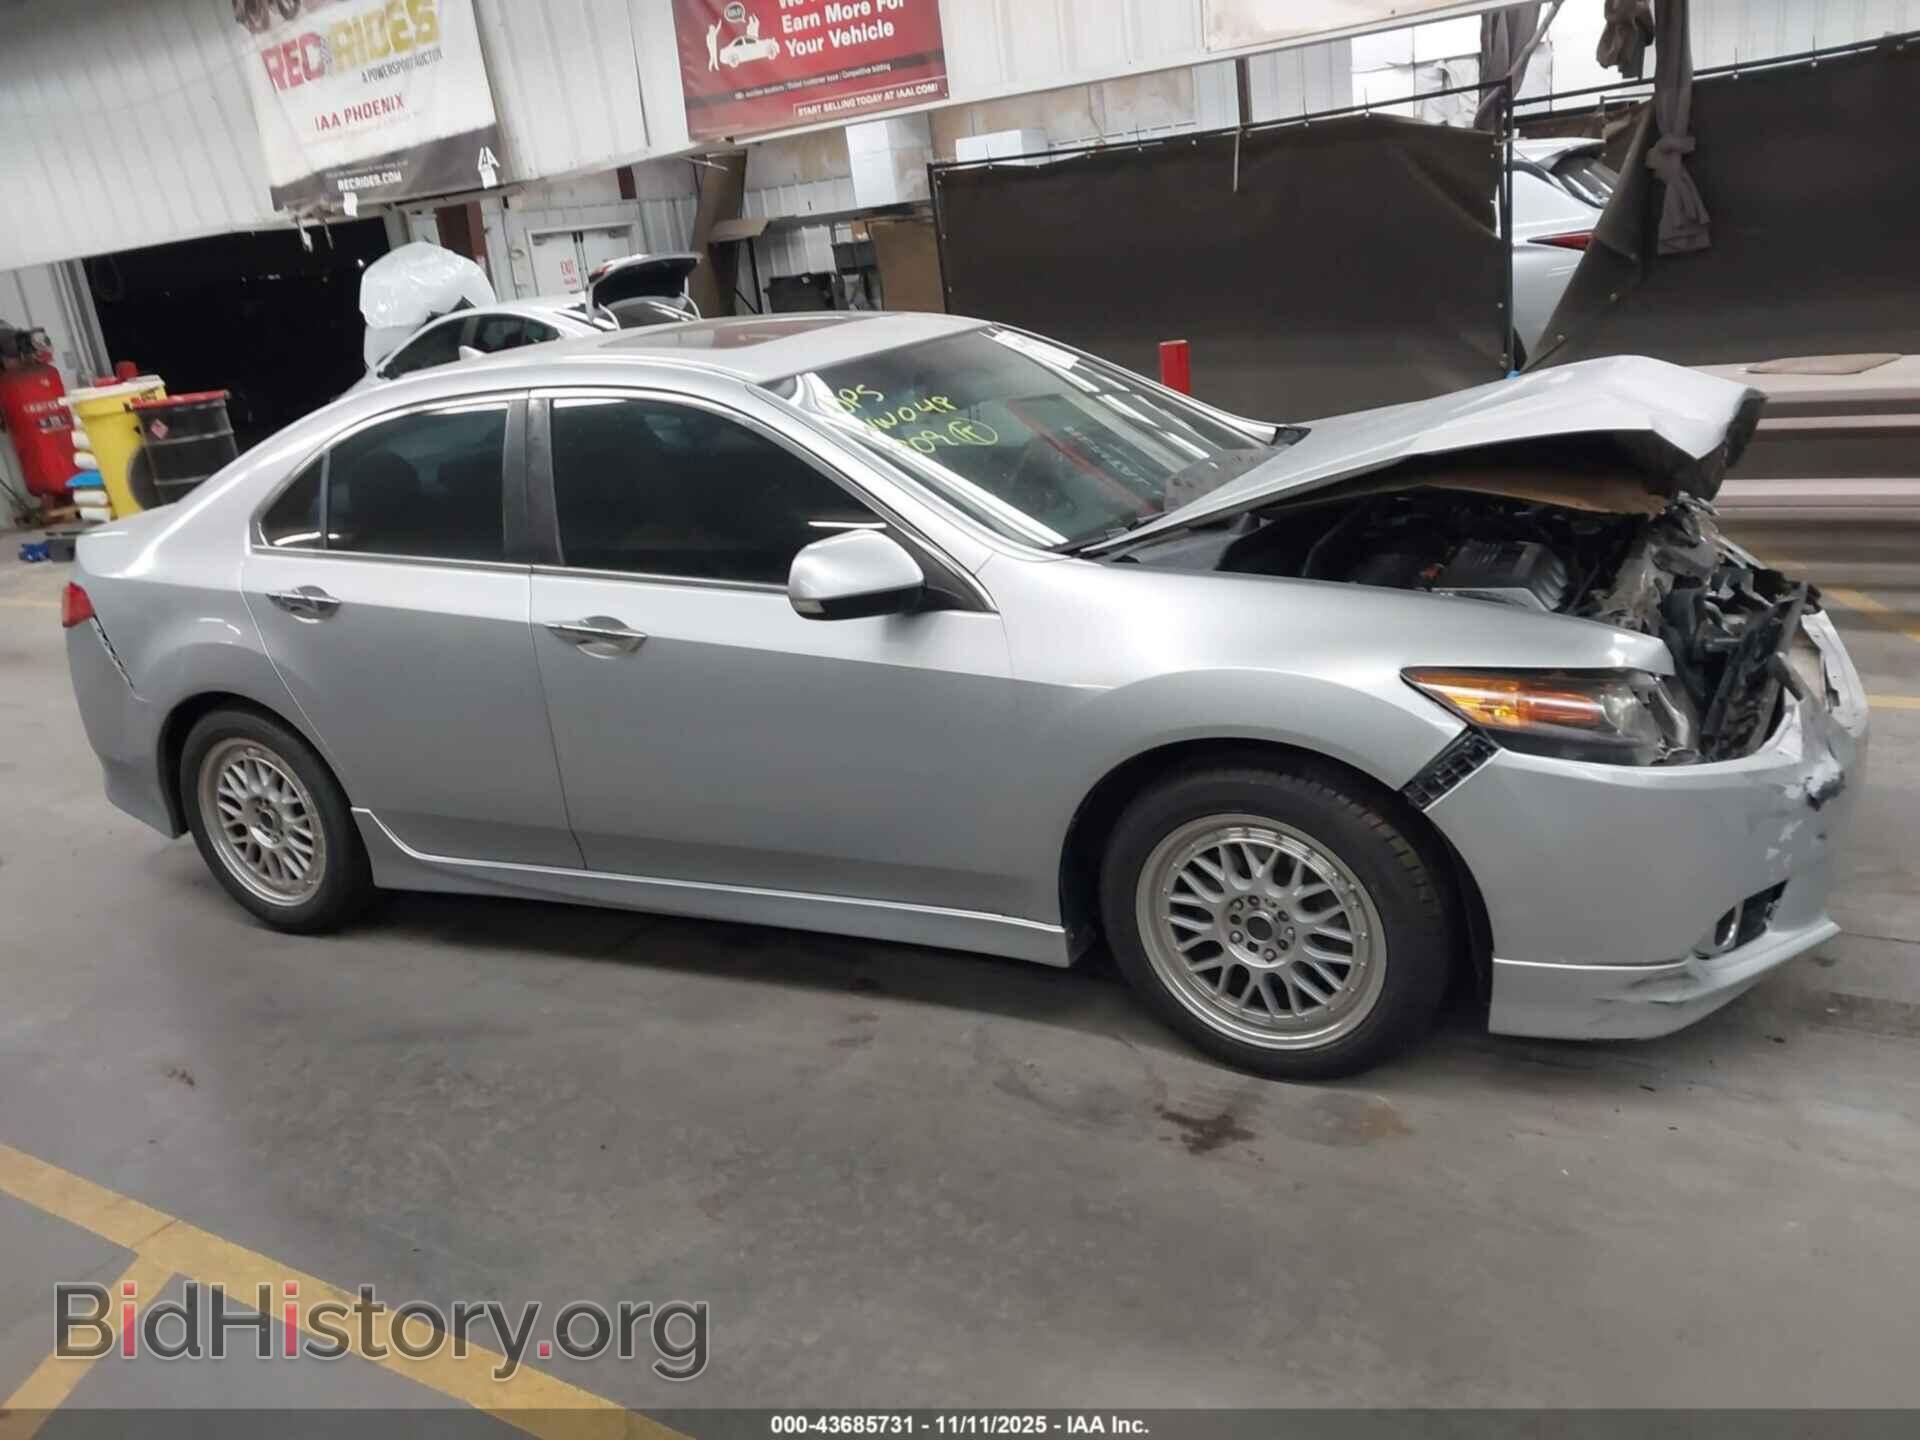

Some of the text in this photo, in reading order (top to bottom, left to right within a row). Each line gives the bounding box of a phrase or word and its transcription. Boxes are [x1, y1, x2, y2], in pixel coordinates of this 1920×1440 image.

[781, 12, 821, 34] Earn
[825, 2, 872, 23] More
[785, 19, 895, 57] Your Vehicle
[262, 32, 326, 91] REC
[314, 94, 405, 132] IAA PHOENIX
[798, 104, 822, 117] START
[822, 97, 856, 114] SELLING
[855, 92, 883, 106] TODAY
[883, 89, 896, 101] AT
